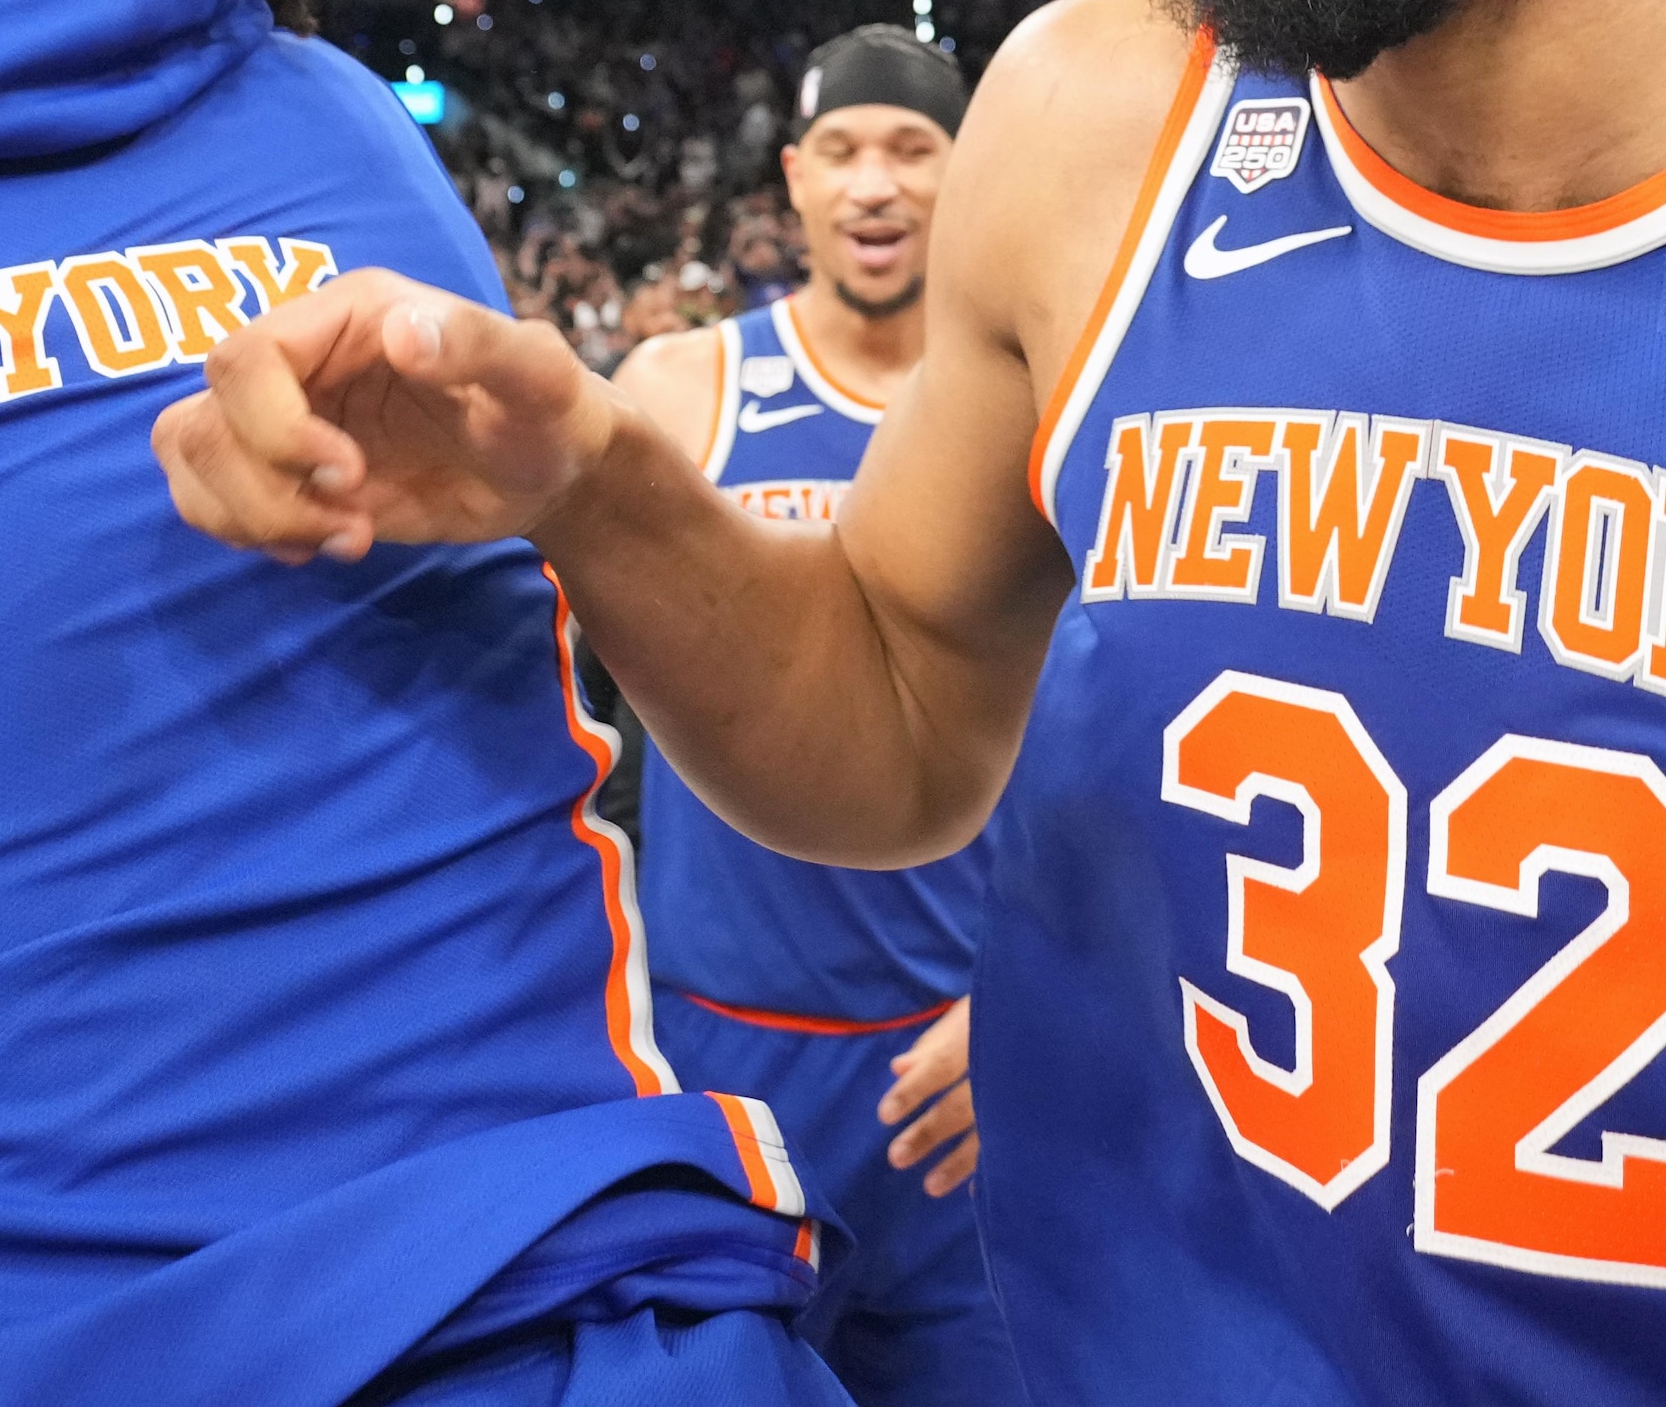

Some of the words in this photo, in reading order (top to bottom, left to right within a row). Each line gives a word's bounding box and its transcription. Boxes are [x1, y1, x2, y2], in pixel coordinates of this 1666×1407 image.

[1234, 111, 1296, 133] USA
[1219, 144, 1292, 170] 250
[1081, 406, 1431, 625] NEW
